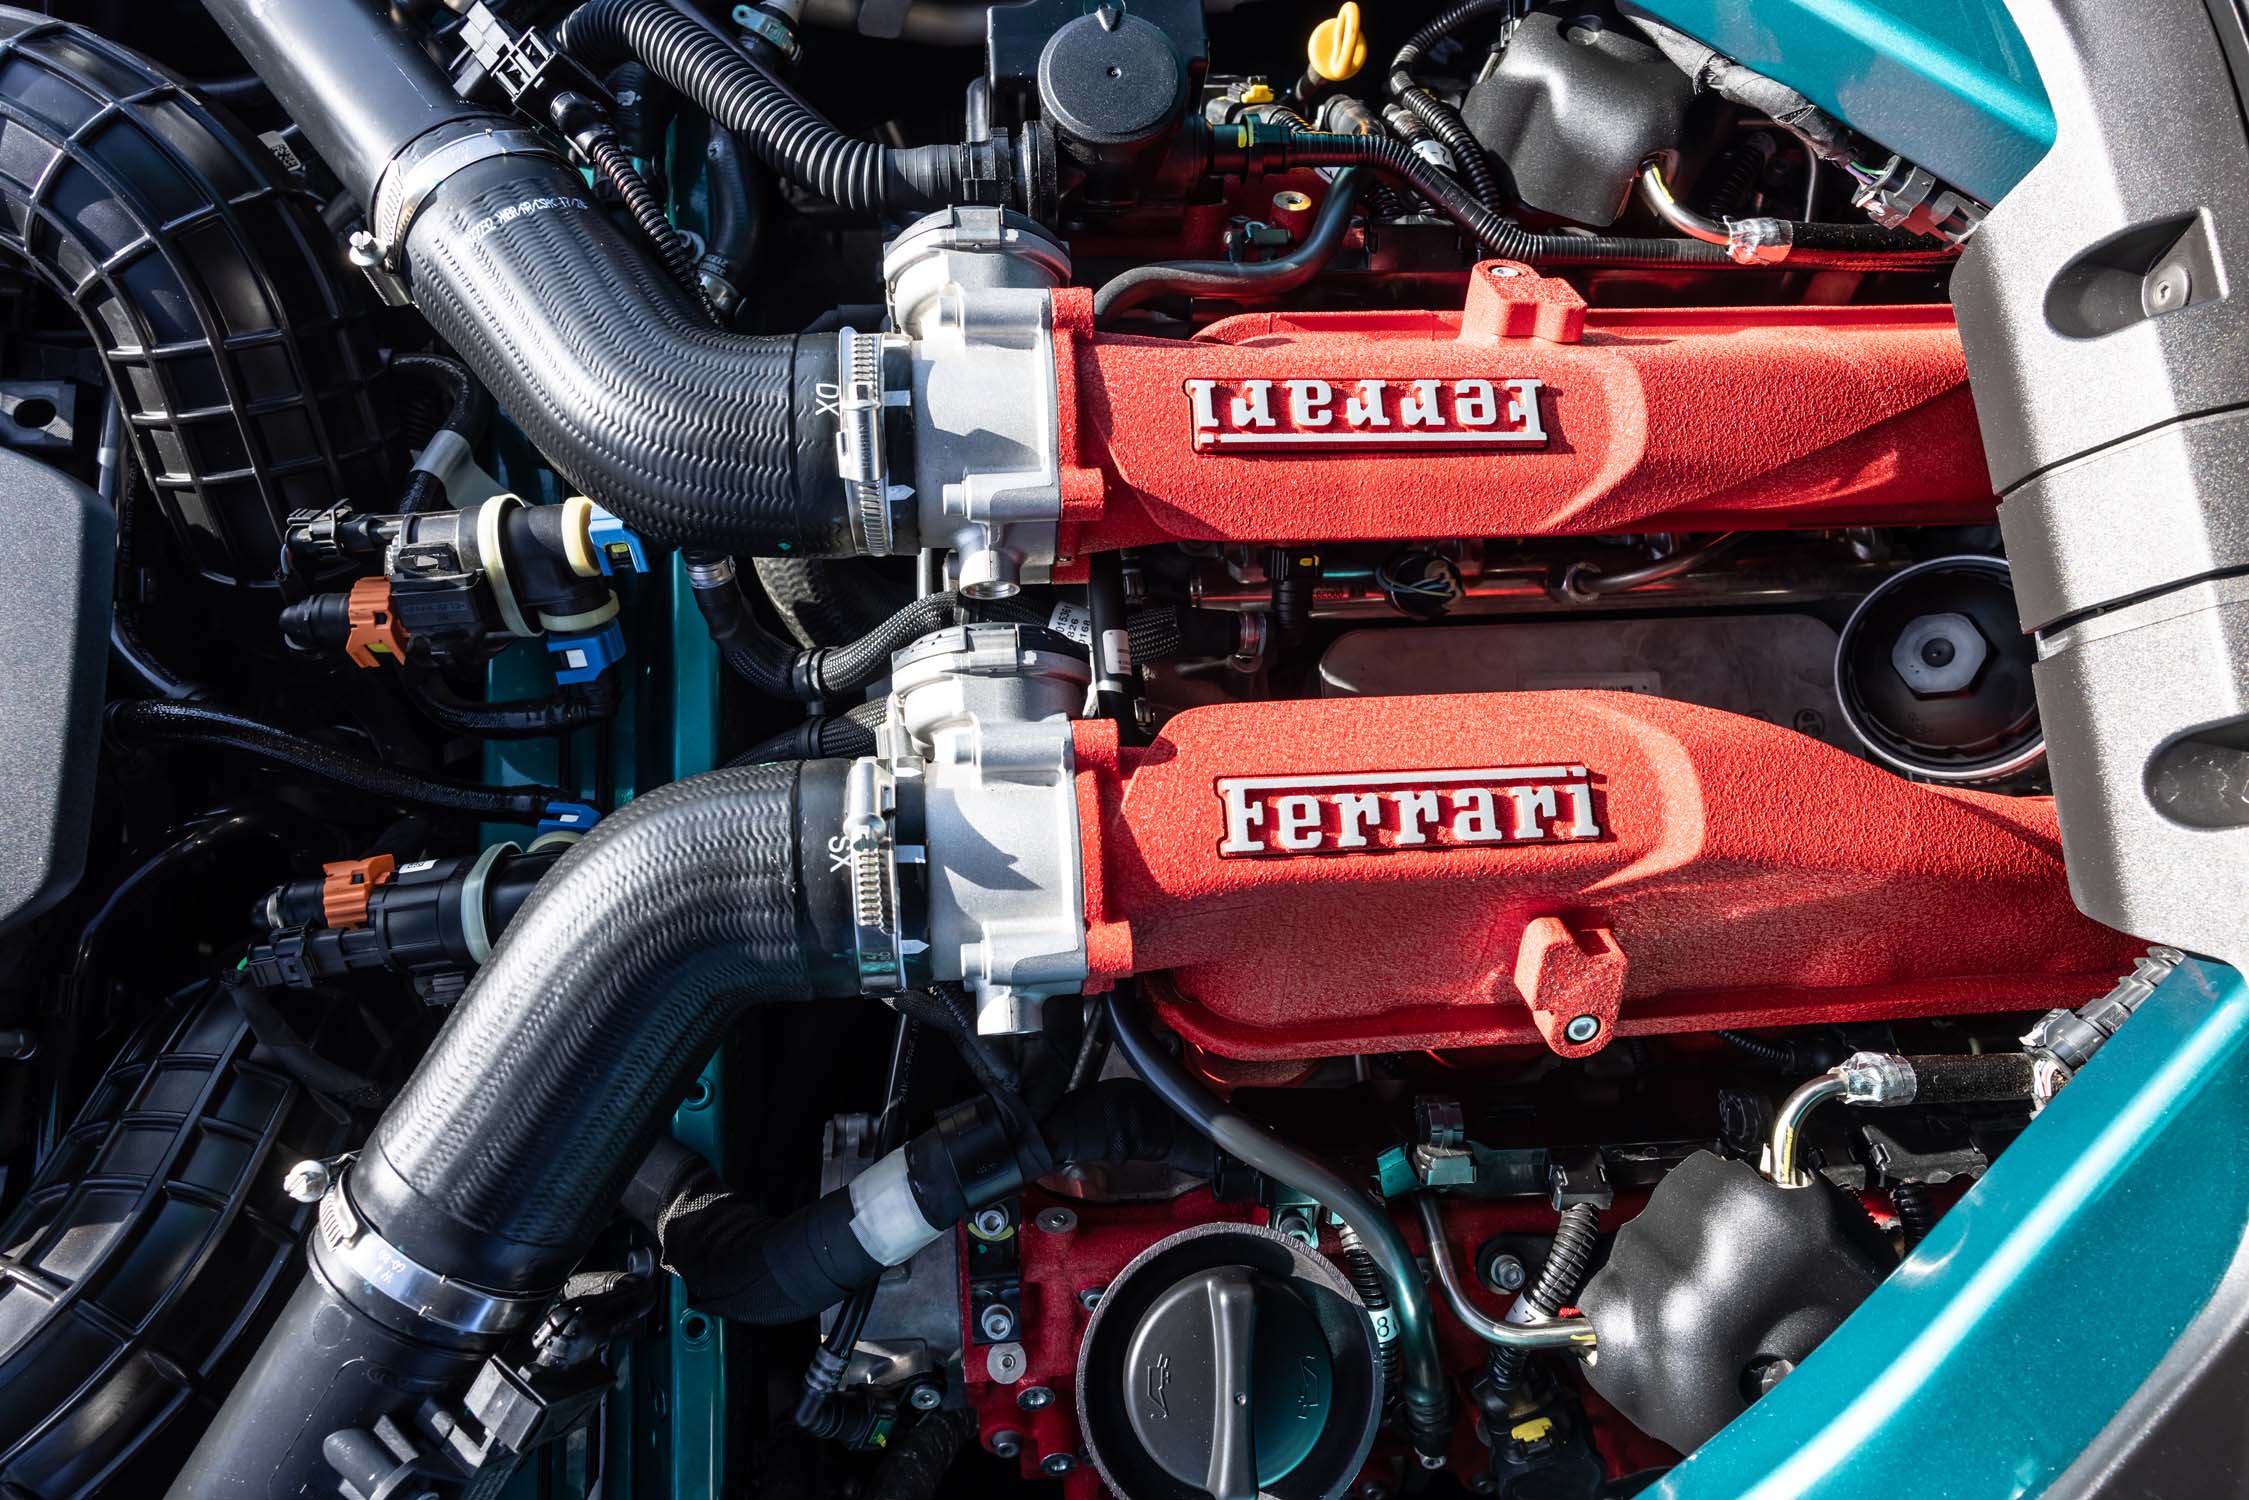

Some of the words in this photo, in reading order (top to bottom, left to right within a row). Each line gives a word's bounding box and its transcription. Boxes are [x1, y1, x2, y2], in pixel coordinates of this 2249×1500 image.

[815, 383, 840, 417] DX
[1187, 379, 1548, 444] Ferrari
[1219, 766, 1600, 854] Ferrari
[828, 836, 852, 873] SX
